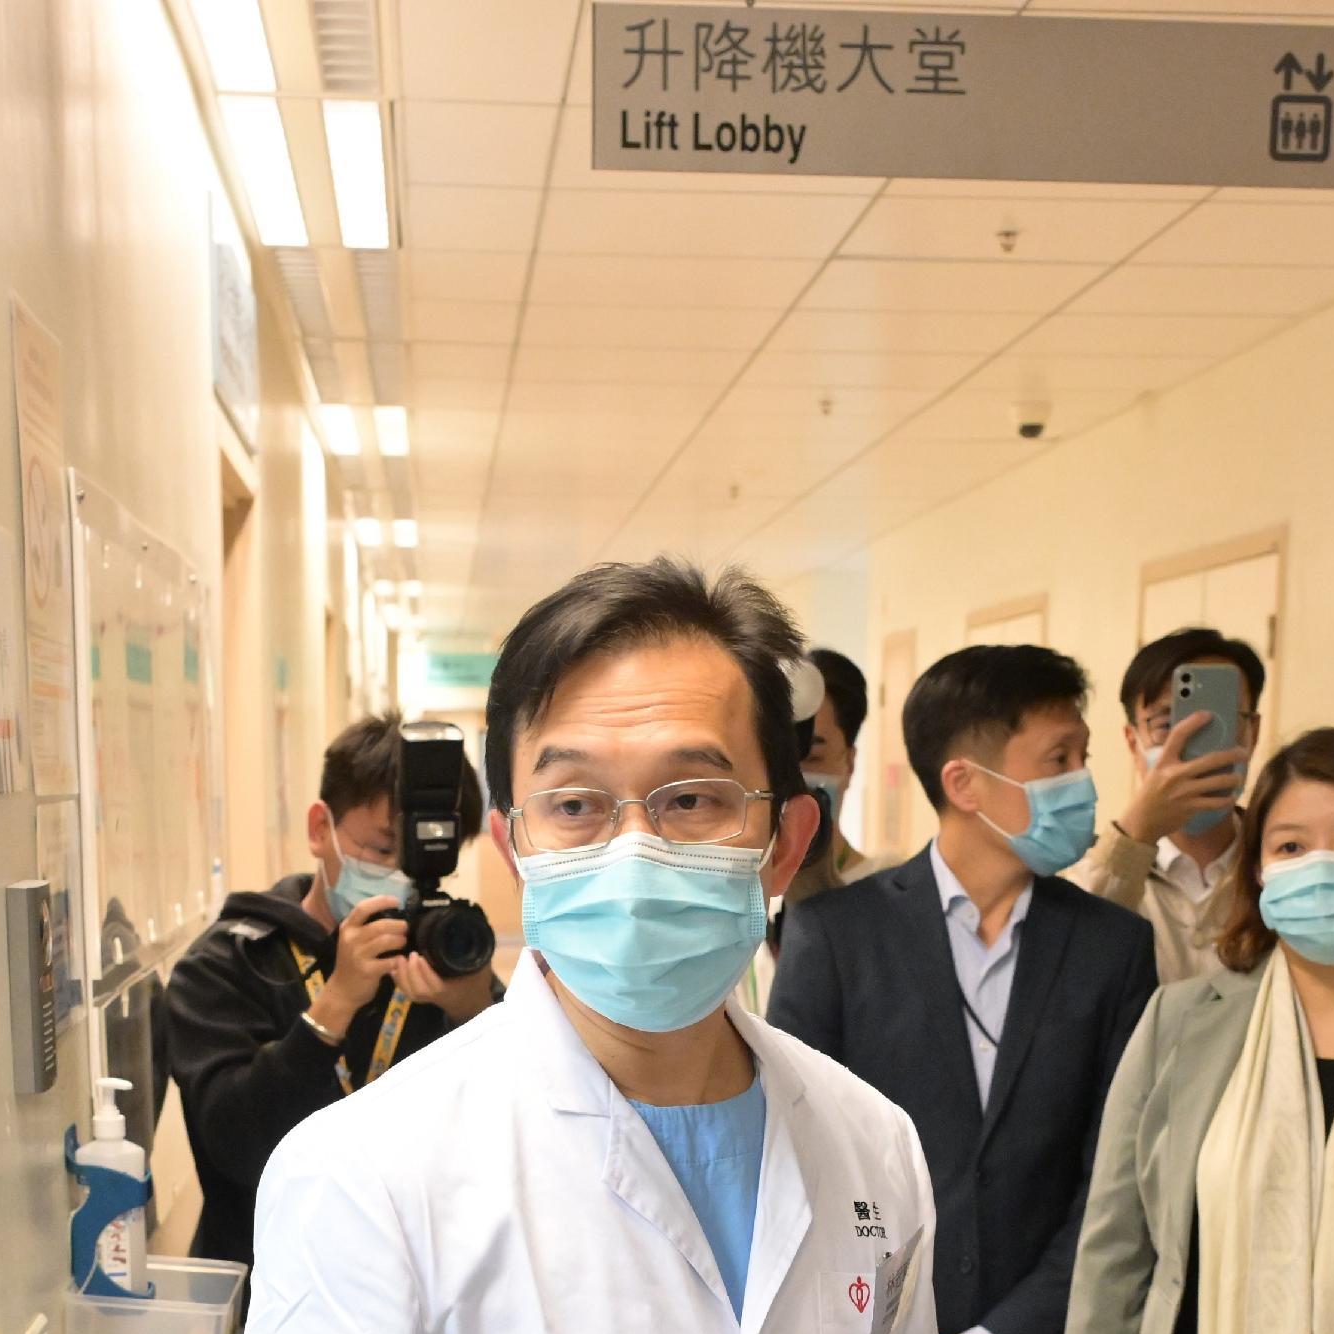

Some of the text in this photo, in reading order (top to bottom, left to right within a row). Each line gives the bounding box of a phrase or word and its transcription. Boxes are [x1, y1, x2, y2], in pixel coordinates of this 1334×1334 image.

[622, 17, 966, 95] 升降機大堂
[621, 110, 806, 164] Lift Lobby
